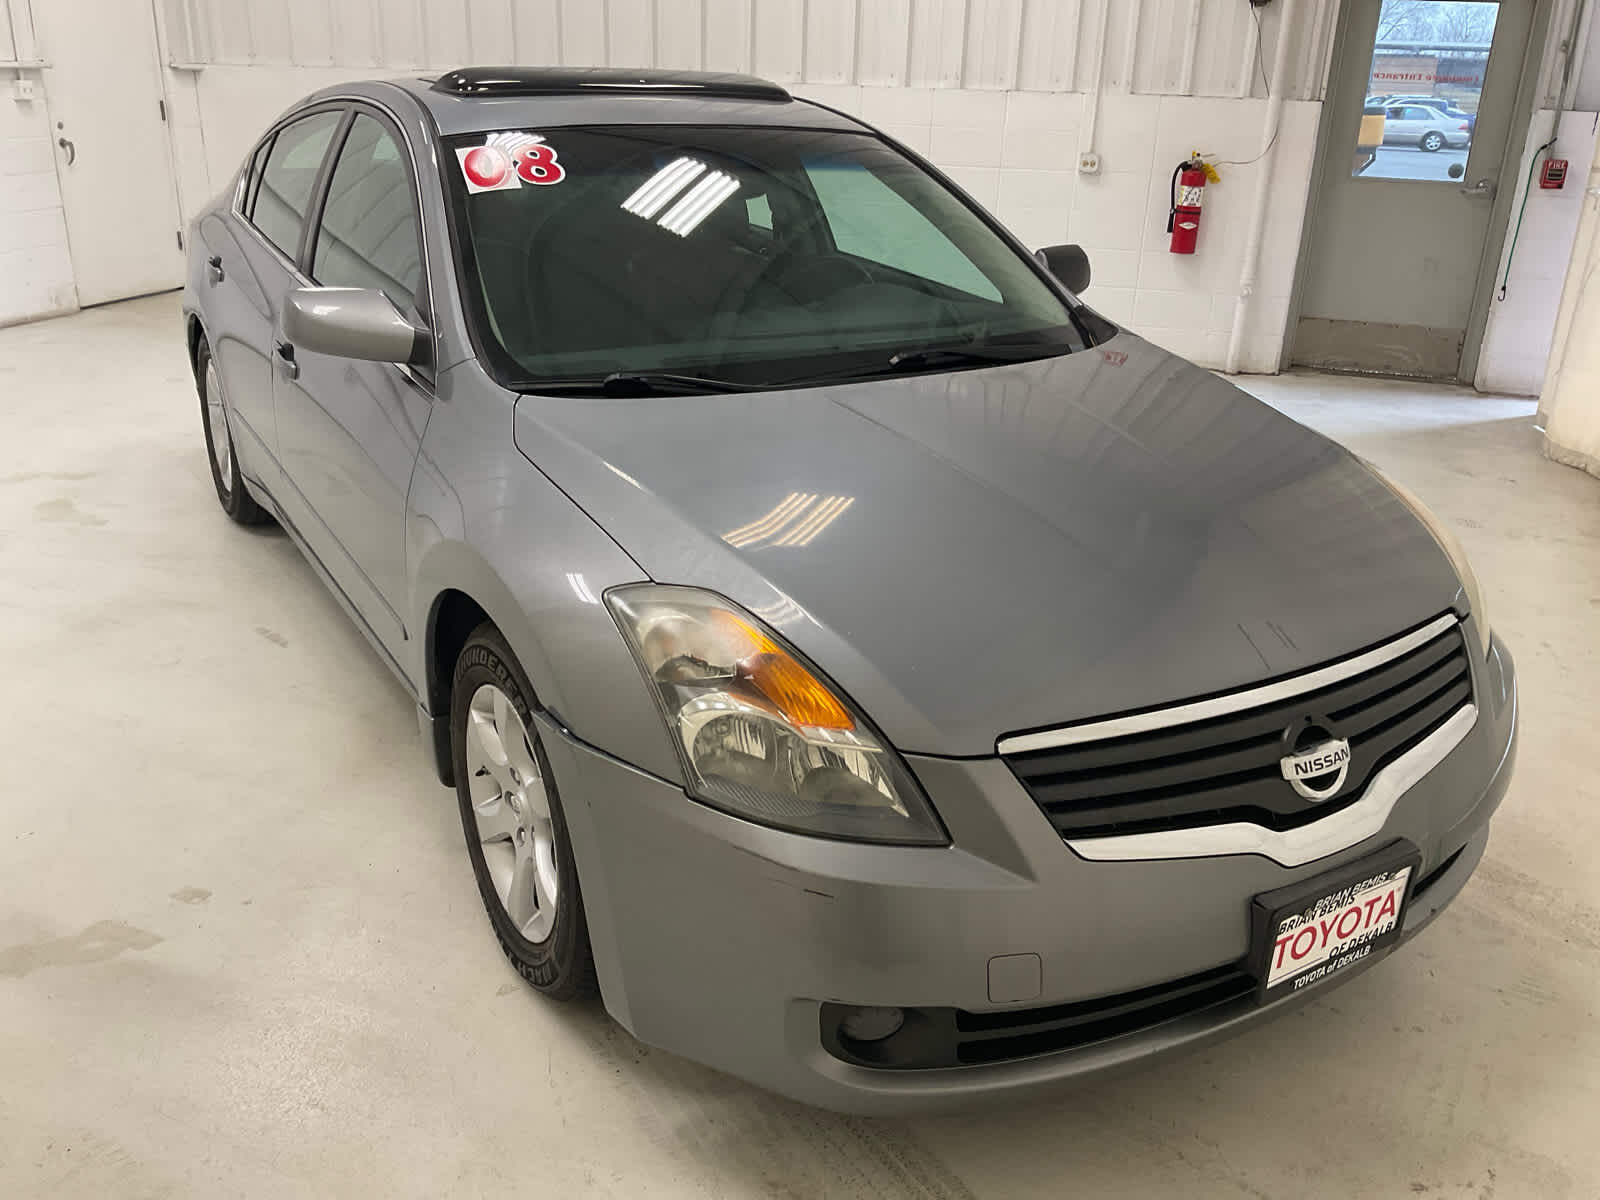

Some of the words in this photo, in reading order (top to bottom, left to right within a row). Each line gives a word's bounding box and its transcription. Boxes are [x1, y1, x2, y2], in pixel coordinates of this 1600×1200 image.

[1548, 159, 1566, 169] FIRE
[1294, 745, 1349, 775] NISSAN
[1313, 887, 1353, 911] BRIAN
[1352, 872, 1388, 894] BEMIS
[1317, 895, 1356, 918] BEMIS
[1275, 890, 1396, 969] TOYOTA
[1329, 942, 1347, 959] OF
[1348, 921, 1394, 949] DEKALB
[1294, 967, 1326, 990] TOYOTA
[1326, 959, 1336, 974] of
[1337, 945, 1371, 969] DEKALB
